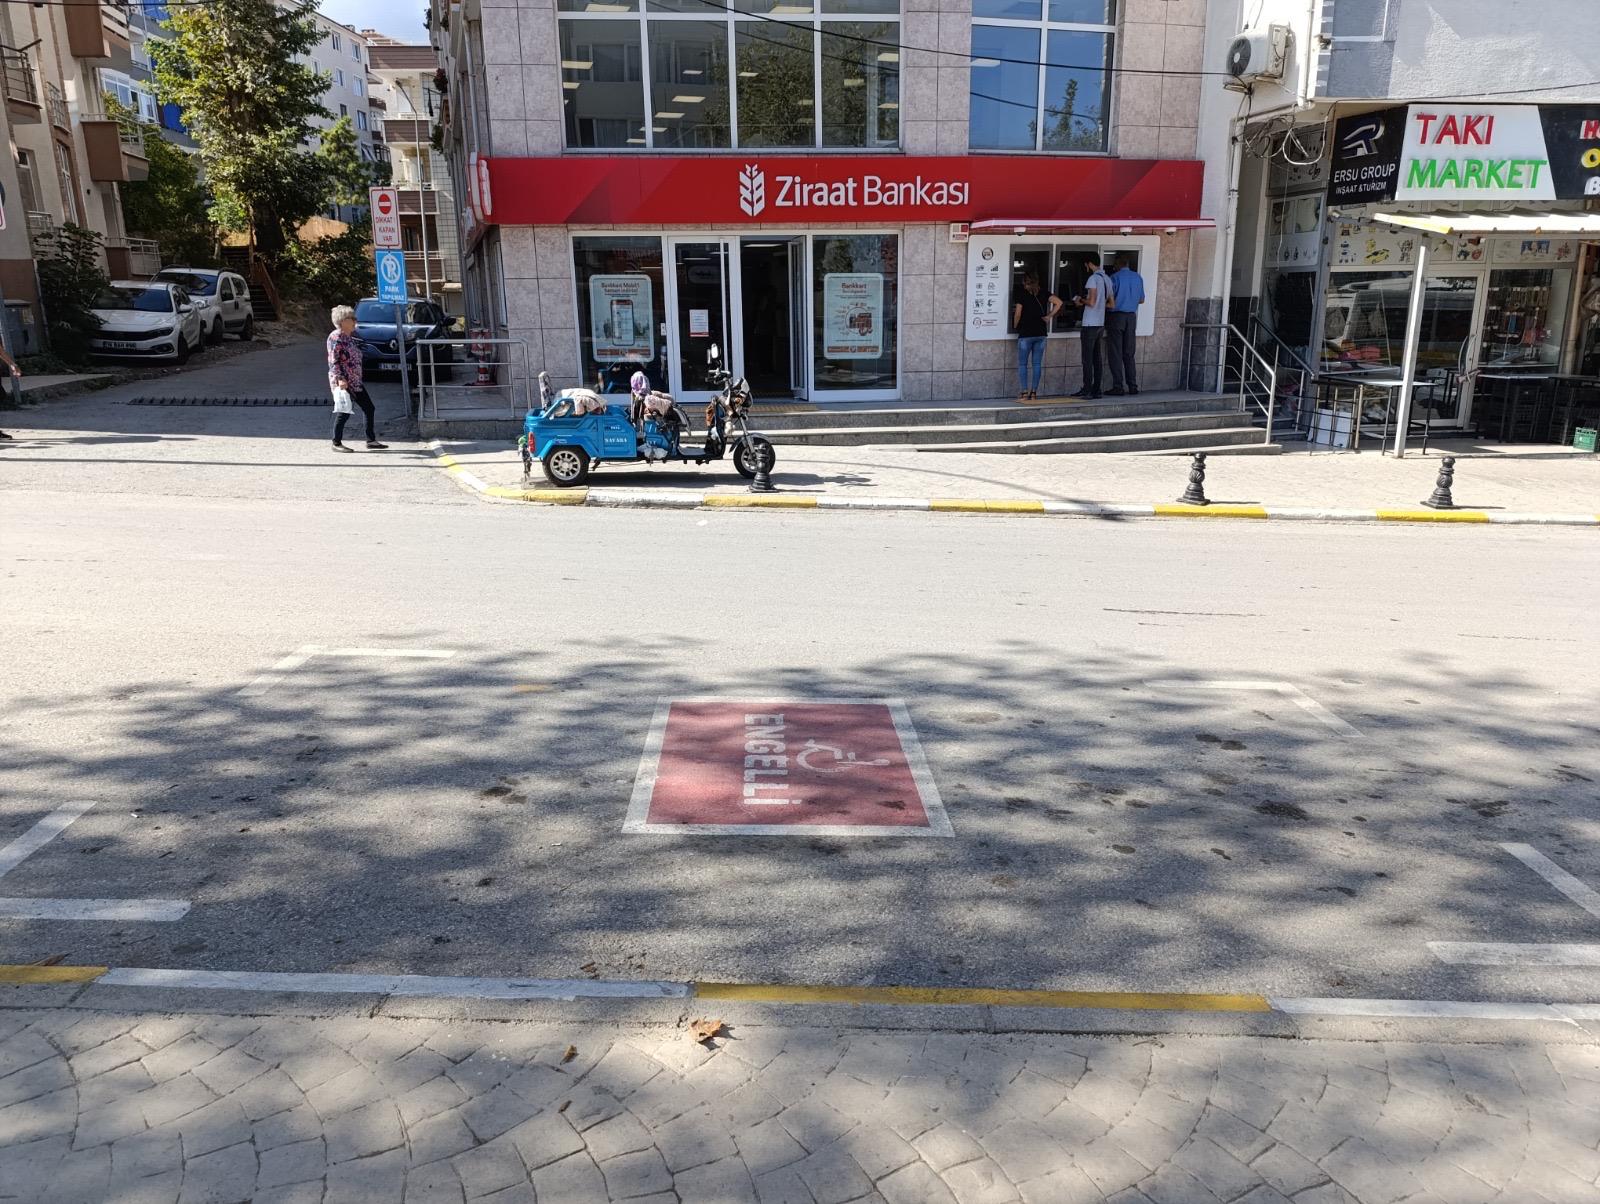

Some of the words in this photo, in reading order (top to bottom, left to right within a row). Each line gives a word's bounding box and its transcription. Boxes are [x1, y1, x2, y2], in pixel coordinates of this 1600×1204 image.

[1416, 114, 1494, 145] TAKI
[1334, 168, 1359, 183] ERSU
[1360, 163, 1396, 180] GROUP
[1406, 159, 1547, 189] MARKET
[775, 175, 858, 207] Ziraat
[863, 175, 969, 206] Bankası
